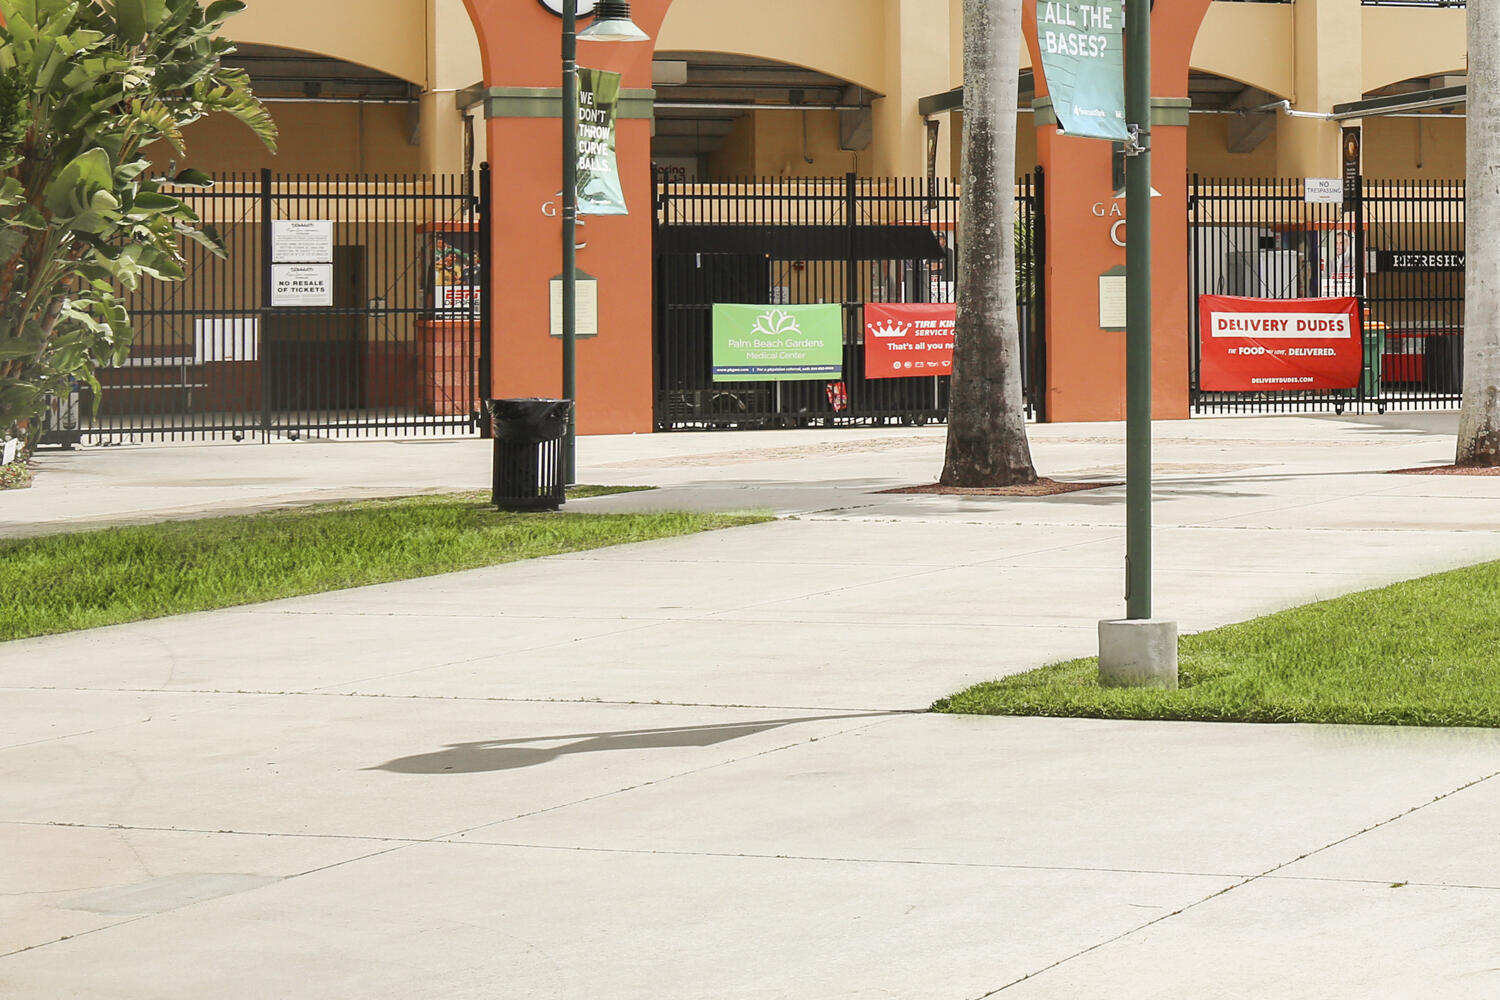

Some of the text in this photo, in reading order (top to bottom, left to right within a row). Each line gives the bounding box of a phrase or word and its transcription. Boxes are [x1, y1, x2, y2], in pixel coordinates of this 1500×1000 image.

[1044, 2, 1113, 29] ALL THE
[1045, 31, 1107, 58] BASES?
[580, 91, 594, 105] WE
[579, 107, 606, 123] DON'T
[579, 124, 611, 140] THROW
[579, 140, 608, 156] CURVE
[578, 157, 611, 172] BALLS.
[915, 320, 955, 329] TIRE KIN
[1218, 318, 1344, 332] DELIVERY DUDES
[915, 329, 948, 337] SERVICE
[728, 338, 824, 348] Palm Beach Gardens
[887, 342, 913, 351] That's
[915, 342, 926, 350] all
[928, 343, 943, 351] you
[746, 351, 805, 359] Medical Center
[1238, 347, 1265, 355] FOOD
[1288, 348, 1337, 356] DELIVERED.
